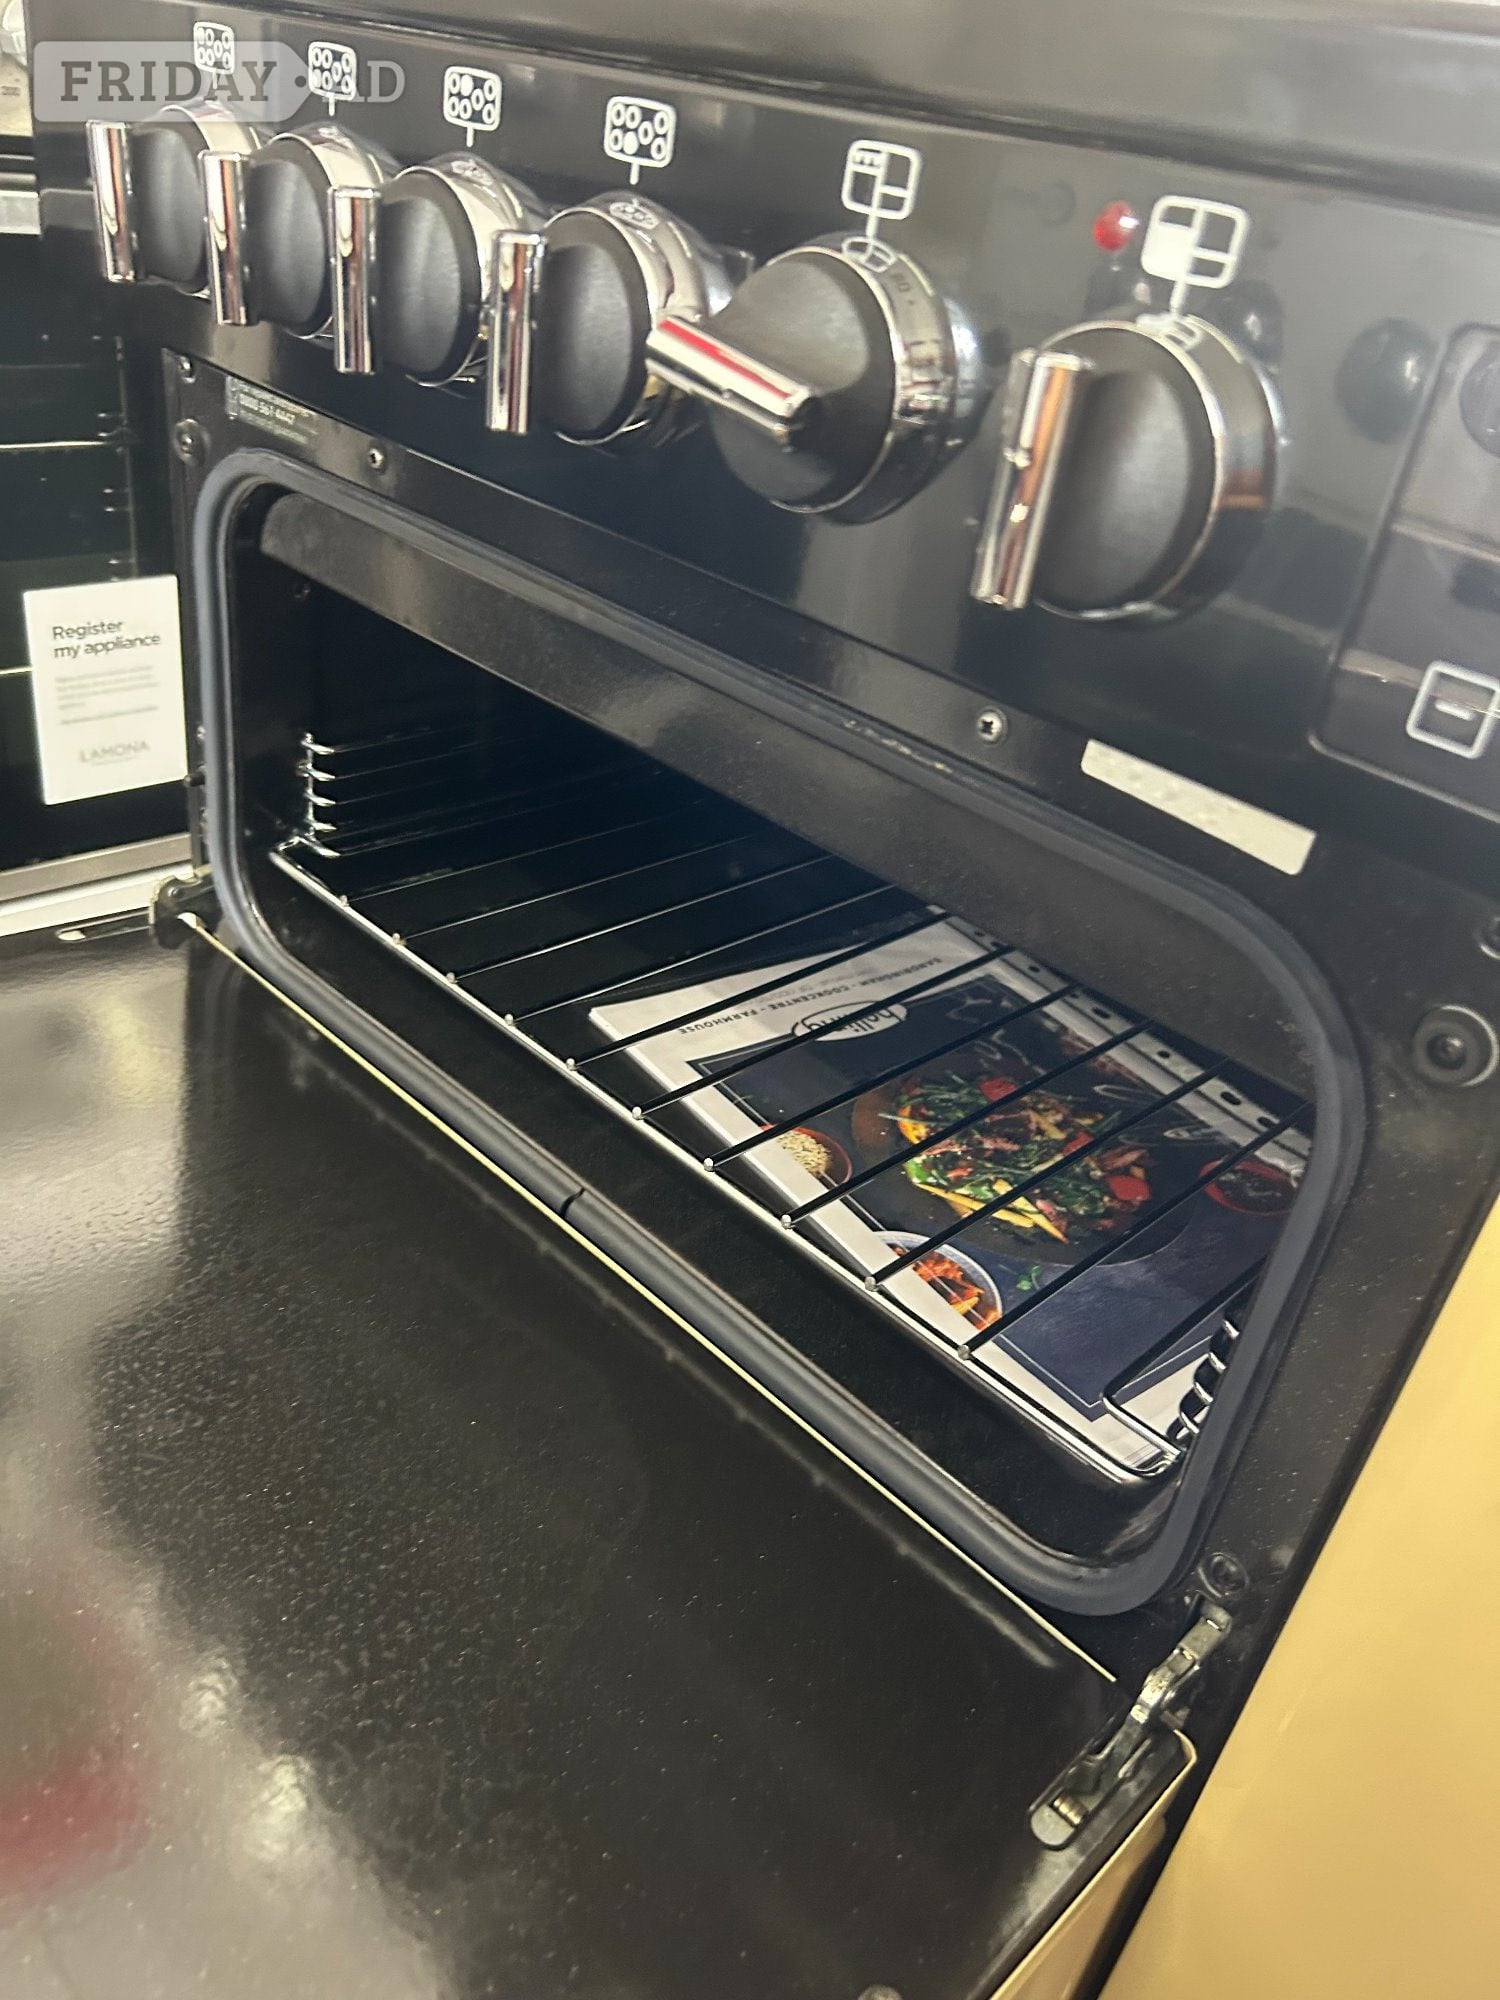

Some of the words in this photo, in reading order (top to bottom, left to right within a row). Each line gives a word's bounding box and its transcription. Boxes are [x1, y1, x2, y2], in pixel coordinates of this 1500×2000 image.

[52, 620, 123, 640] Register
[54, 645, 80, 659] my
[84, 635, 161, 656] appliance
[79, 740, 150, 763] LAMONA
[770, 984, 850, 1011] COOKCENTRE
[678, 1008, 759, 1035] FARMHOUSE
